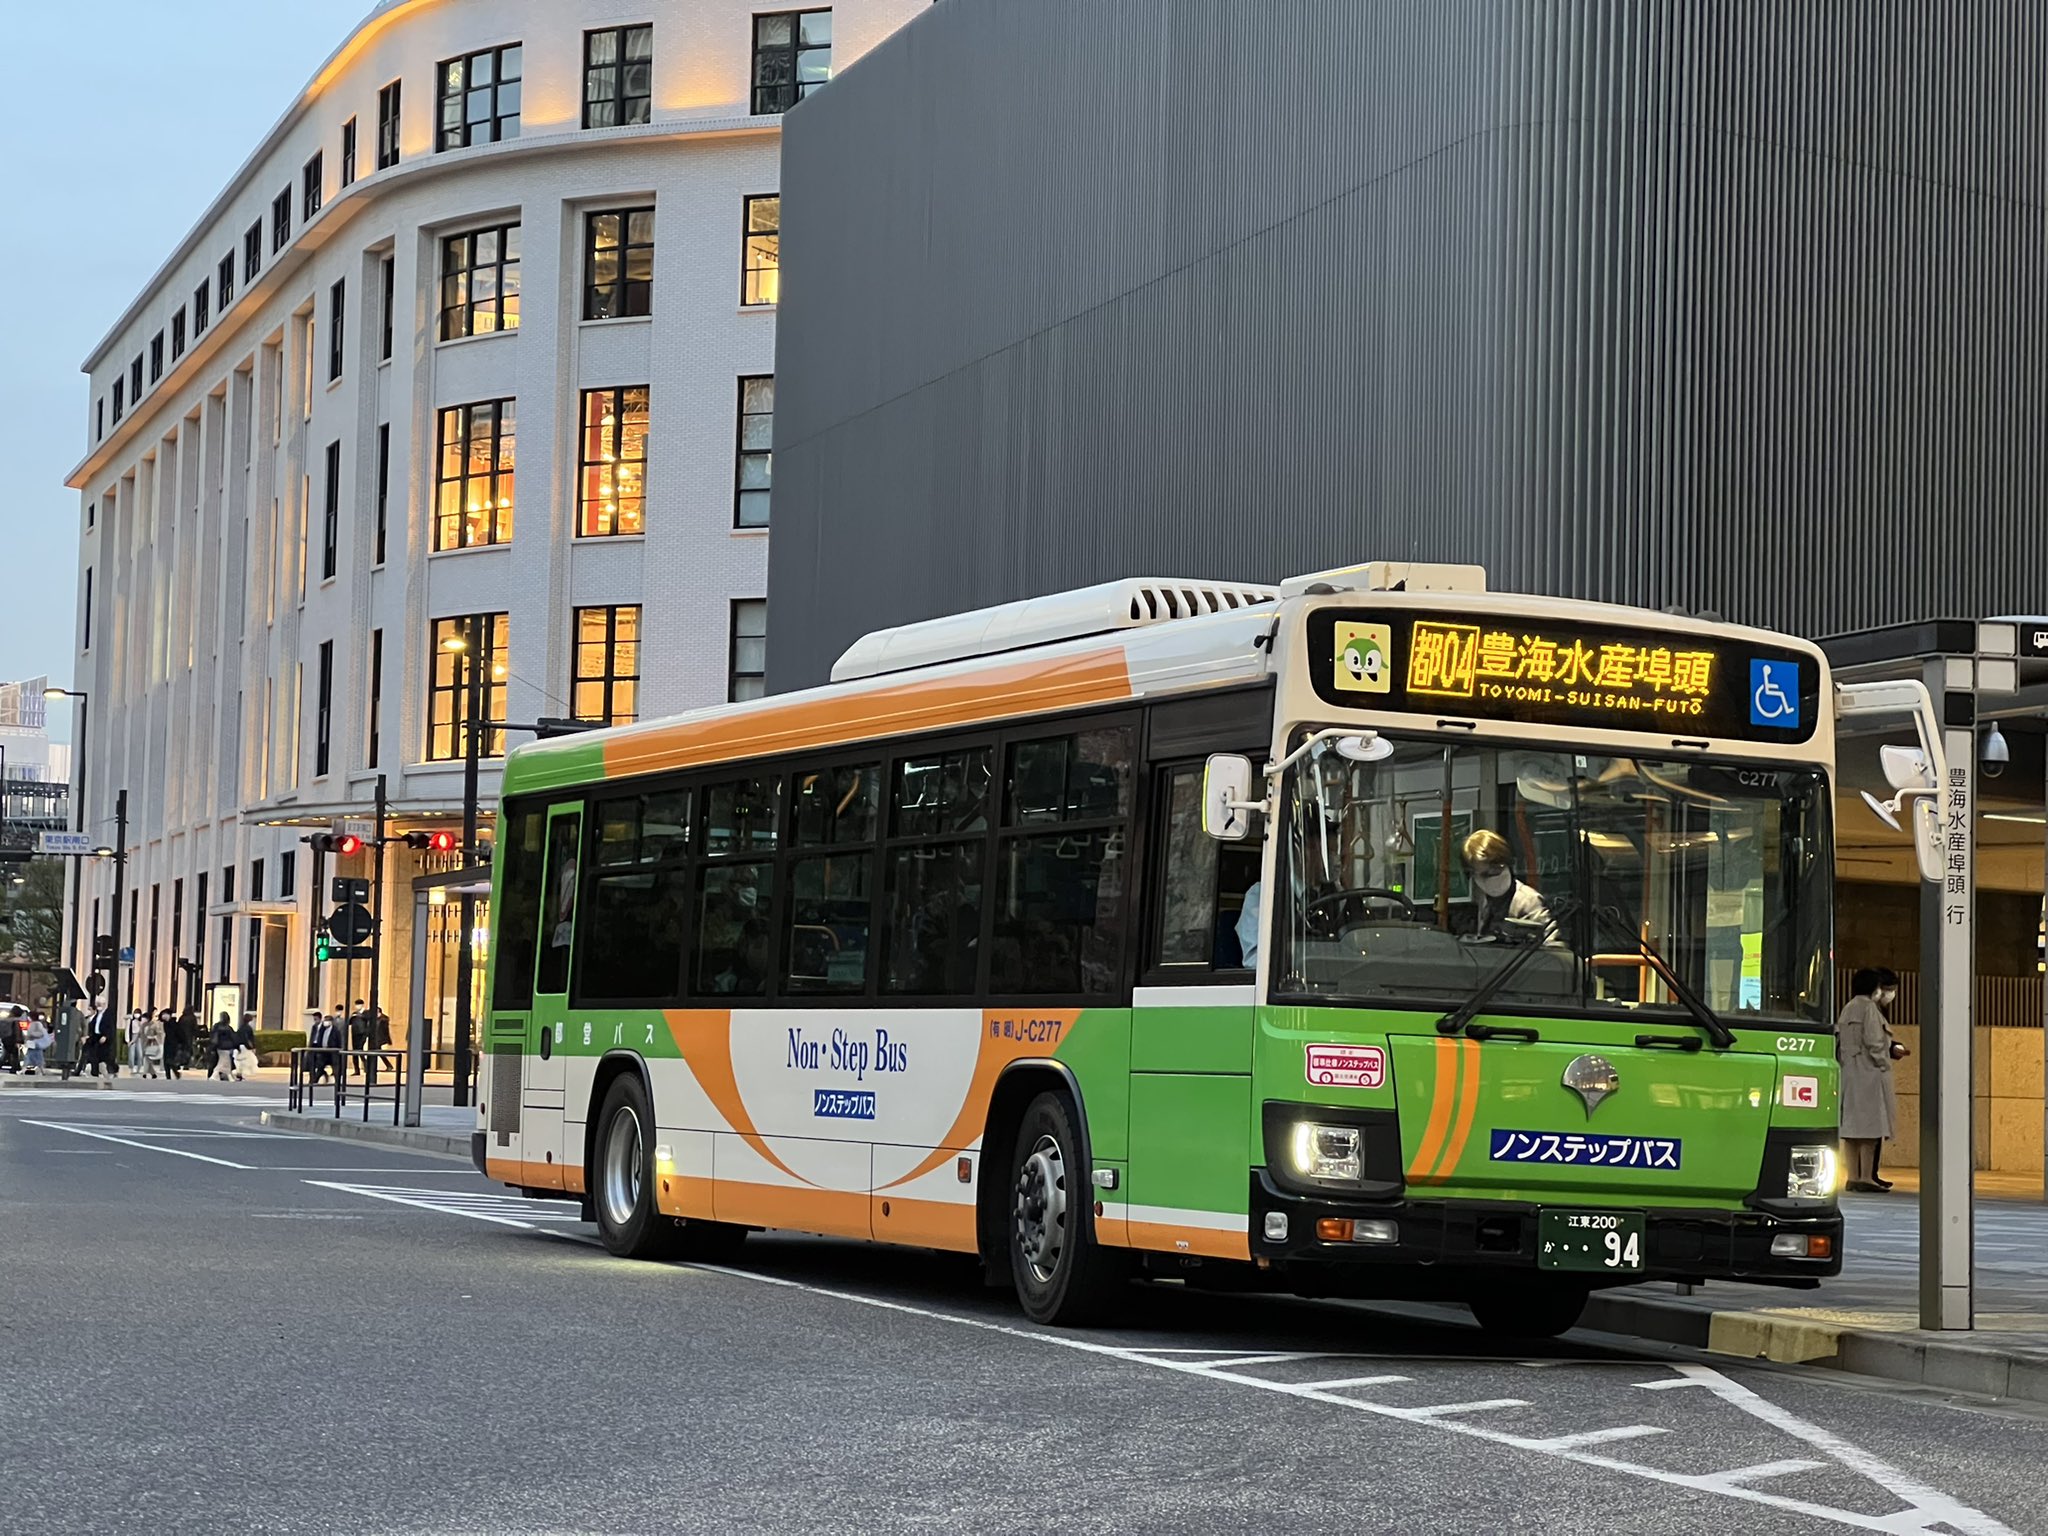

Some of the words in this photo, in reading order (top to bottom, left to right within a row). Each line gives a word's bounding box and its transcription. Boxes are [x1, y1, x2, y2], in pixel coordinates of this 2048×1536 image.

[1413, 628, 1475, 690] 都04
[1475, 631, 1715, 696] 豊海水産埠頭
[1738, 770, 1778, 788] C277
[1948, 768, 1967, 894] 豊海水産埠頭
[1946, 904, 1965, 925] 行
[874, 1029, 907, 1072] Bus
[1776, 1036, 1816, 1052] C277
[814, 1093, 875, 1115] ノンステップバス
[1493, 1133, 1678, 1168] ノンステップバス
